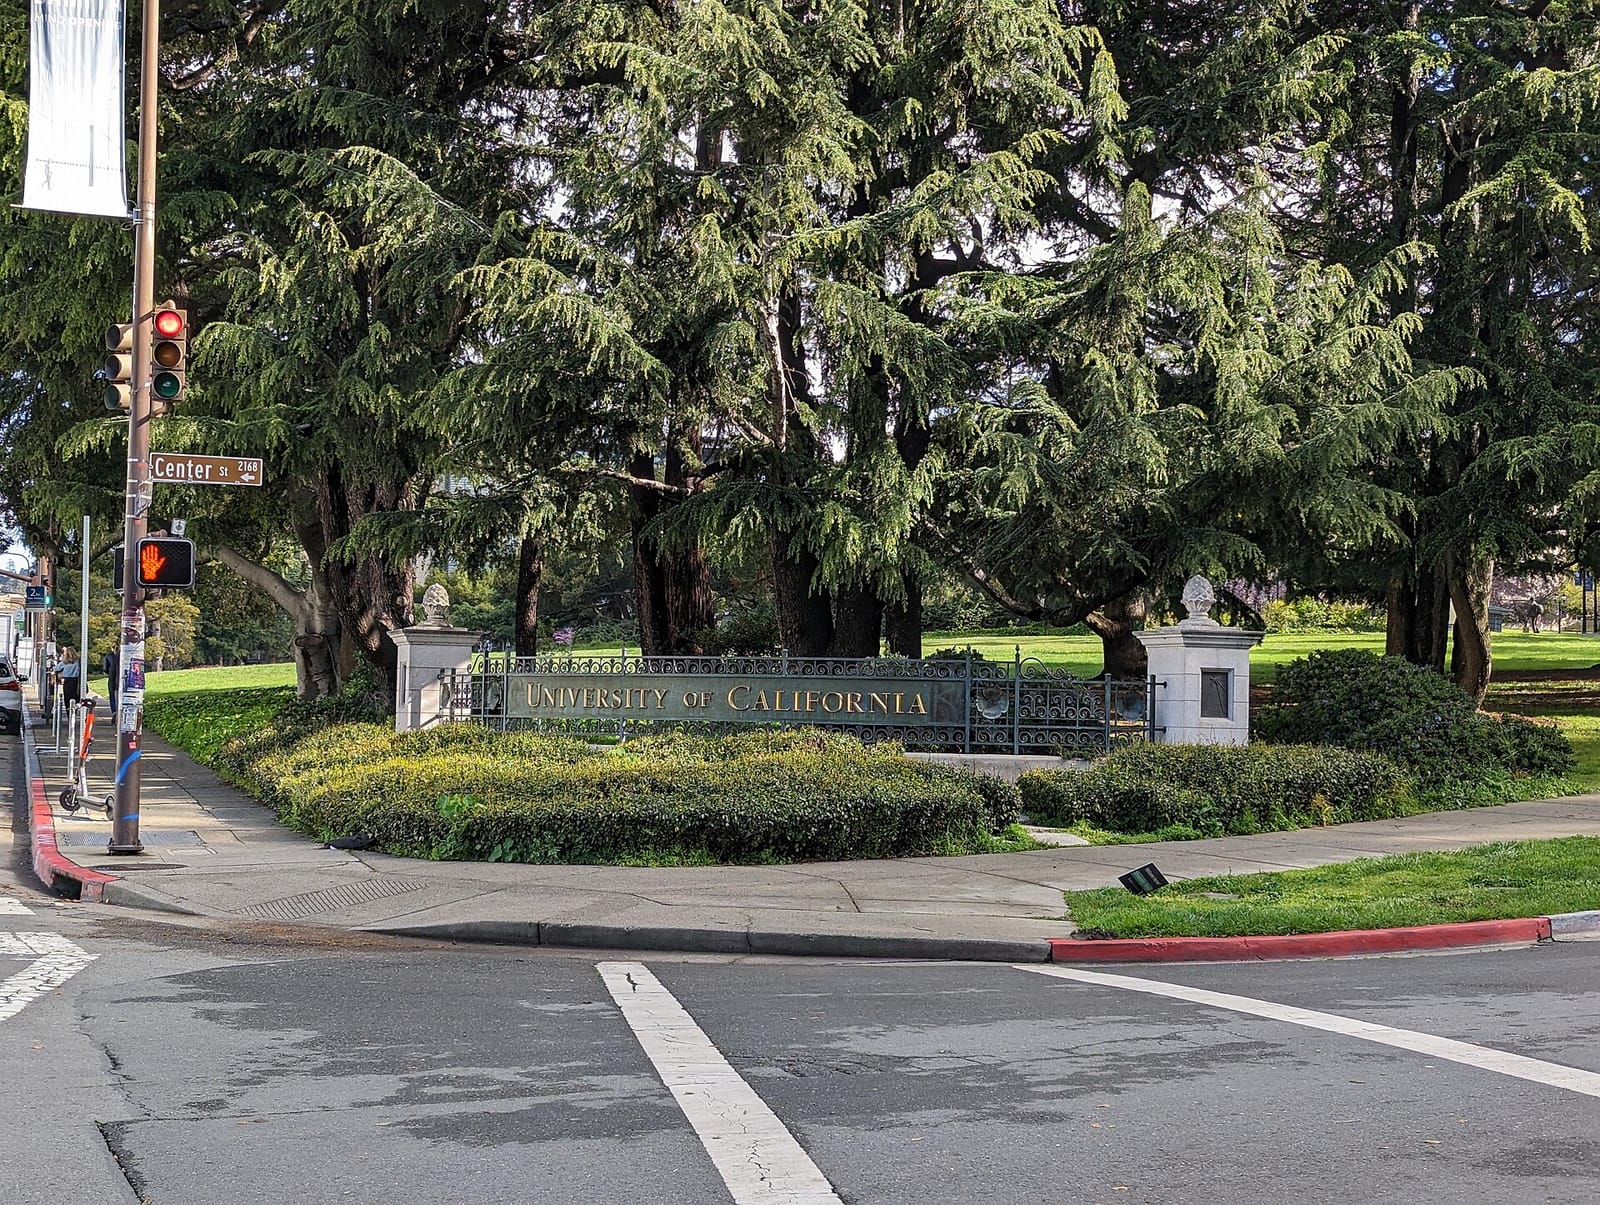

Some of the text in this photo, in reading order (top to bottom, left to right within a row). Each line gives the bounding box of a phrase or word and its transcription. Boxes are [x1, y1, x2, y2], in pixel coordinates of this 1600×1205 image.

[68, 16, 122, 30] OPENIG
[155, 457, 229, 480] Center St
[237, 460, 258, 472] 2168
[30, 588, 36, 597] 2
[526, 683, 668, 709] UNIVERSITY
[683, 691, 714, 708] OF
[727, 685, 928, 714] CALIFORNIA
